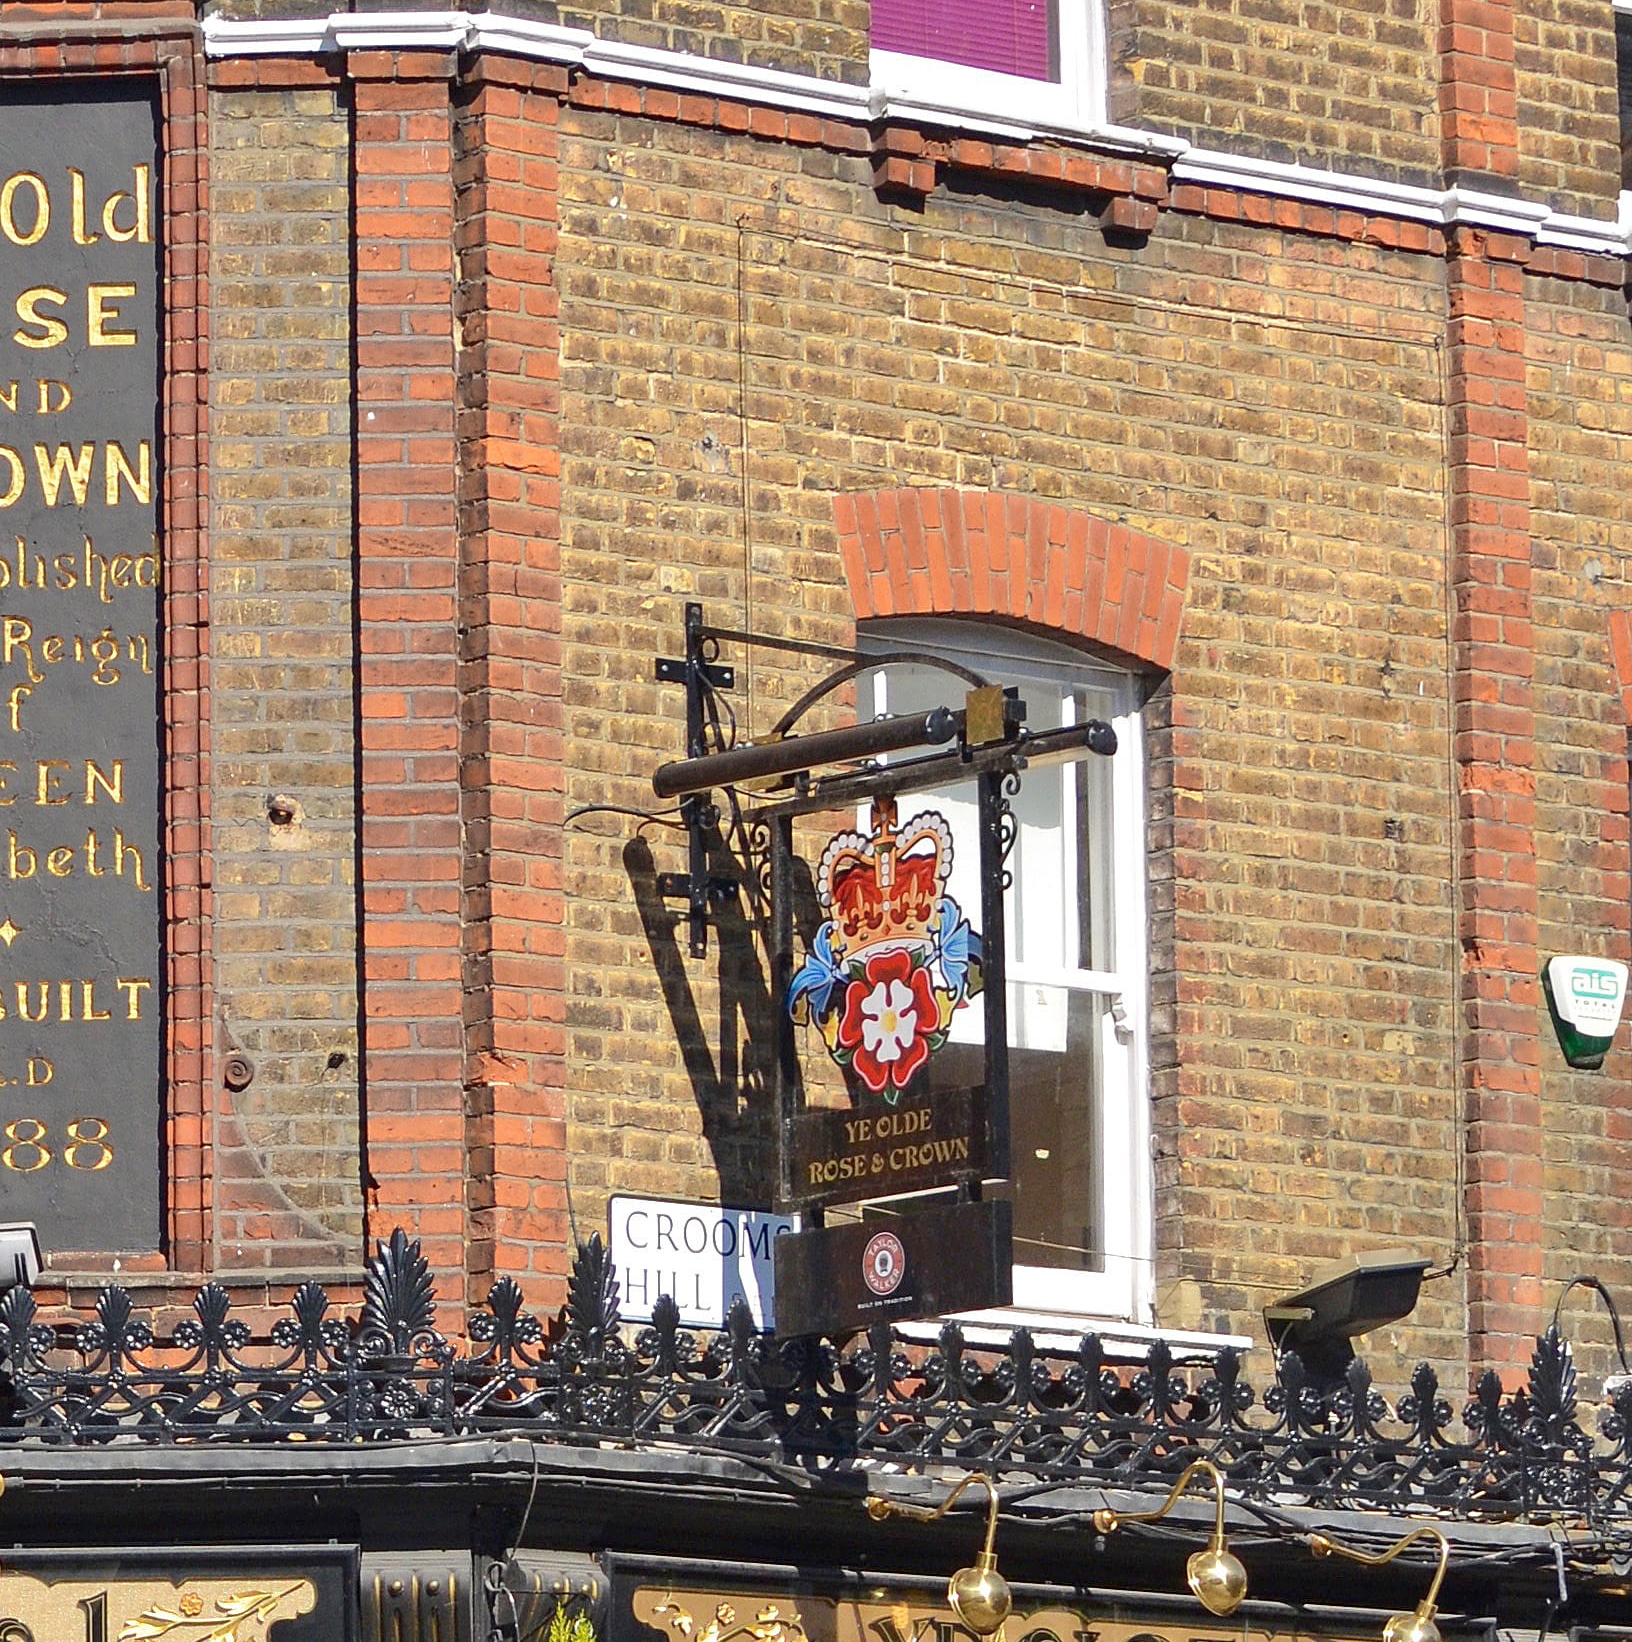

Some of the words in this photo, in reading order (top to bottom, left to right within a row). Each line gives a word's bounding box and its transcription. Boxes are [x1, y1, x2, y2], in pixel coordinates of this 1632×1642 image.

[0, 162, 154, 246] Old
[0, 614, 154, 686] Reign
[845, 1119, 872, 1143] YE
[876, 1108, 932, 1138] OLDE
[809, 1154, 867, 1184] ROSE
[871, 1153, 885, 1173] &
[889, 1136, 969, 1171] CROWN
[626, 1267, 711, 1311] HILL
